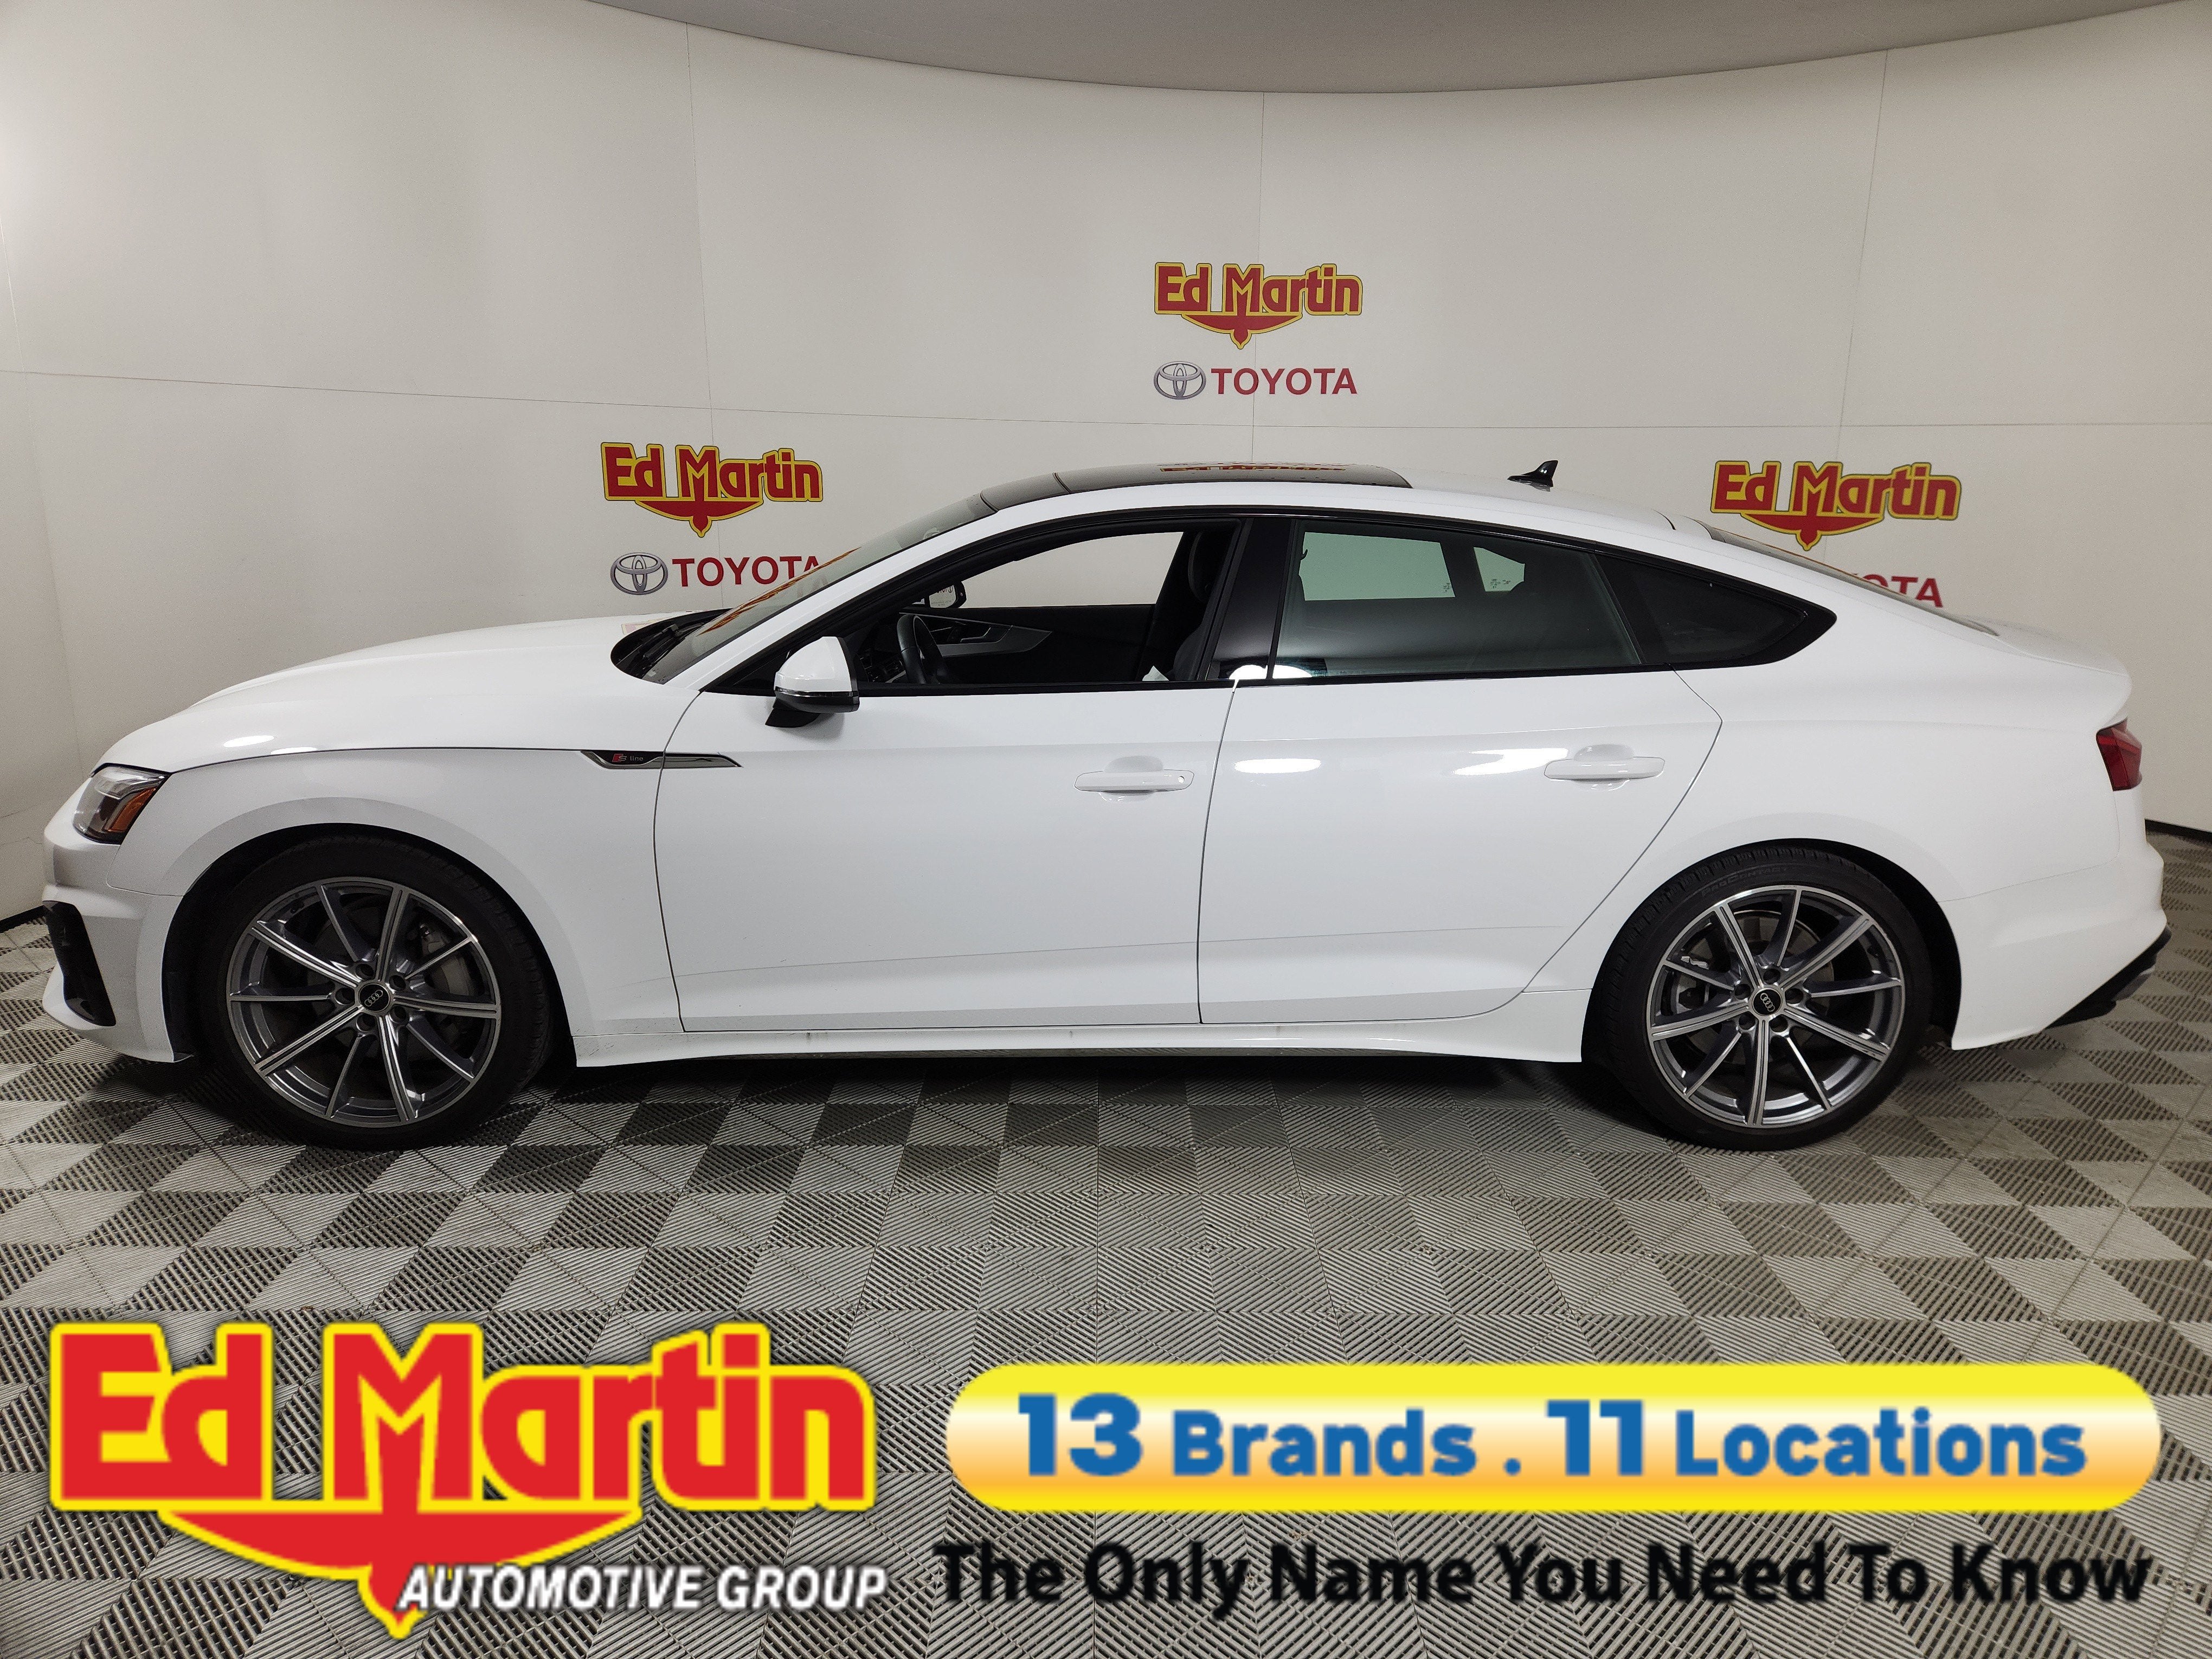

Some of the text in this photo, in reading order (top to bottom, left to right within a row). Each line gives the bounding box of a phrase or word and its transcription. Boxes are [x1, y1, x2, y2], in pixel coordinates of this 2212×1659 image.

[1155, 263, 1362, 314] Ed Martin
[1211, 368, 1358, 395] TOYOTA
[602, 443, 822, 501] Ed Martin
[1712, 462, 1960, 519] Ed Martin
